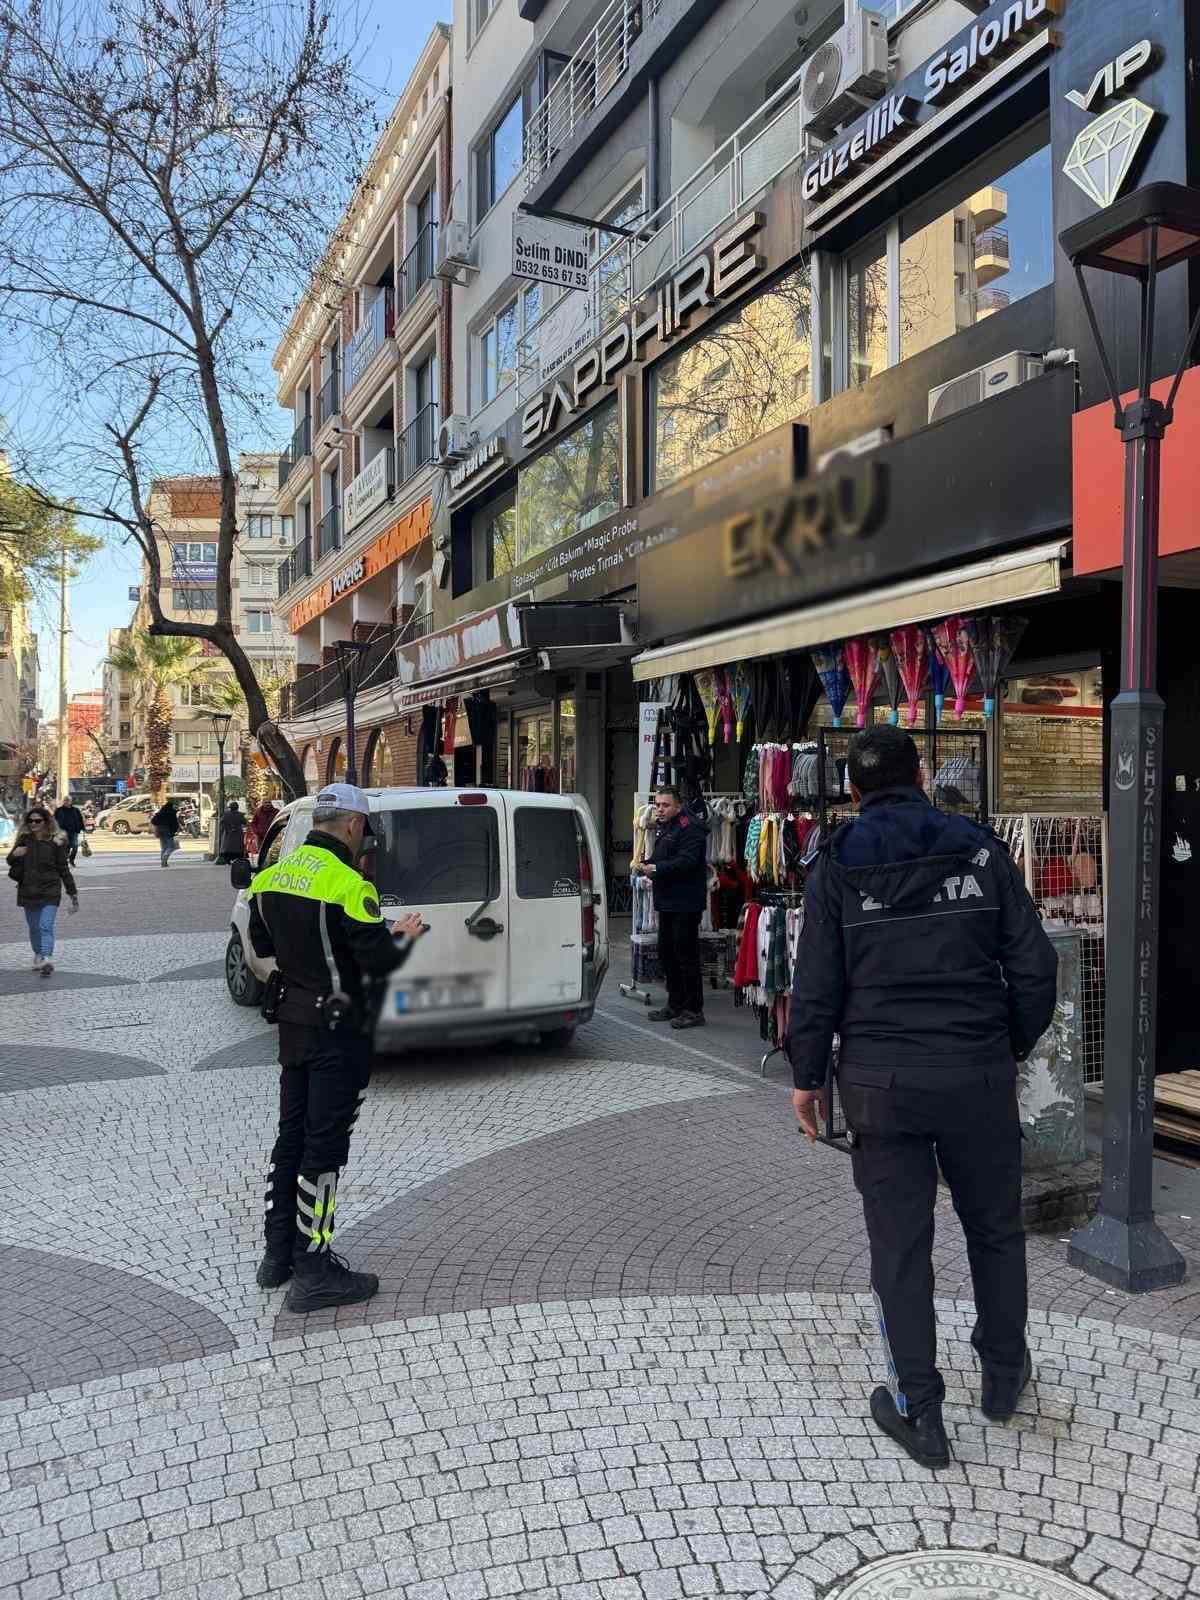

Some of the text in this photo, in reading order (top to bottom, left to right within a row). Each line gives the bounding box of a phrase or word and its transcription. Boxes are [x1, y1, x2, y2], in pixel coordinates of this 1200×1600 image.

[1063, 39, 1151, 111] VIP
[801, 94, 905, 200] Güzellik
[515, 236, 550, 261] Selim
[515, 259, 588, 286] 0532 653 67 53
[521, 211, 764, 448] SAPPHIRE
